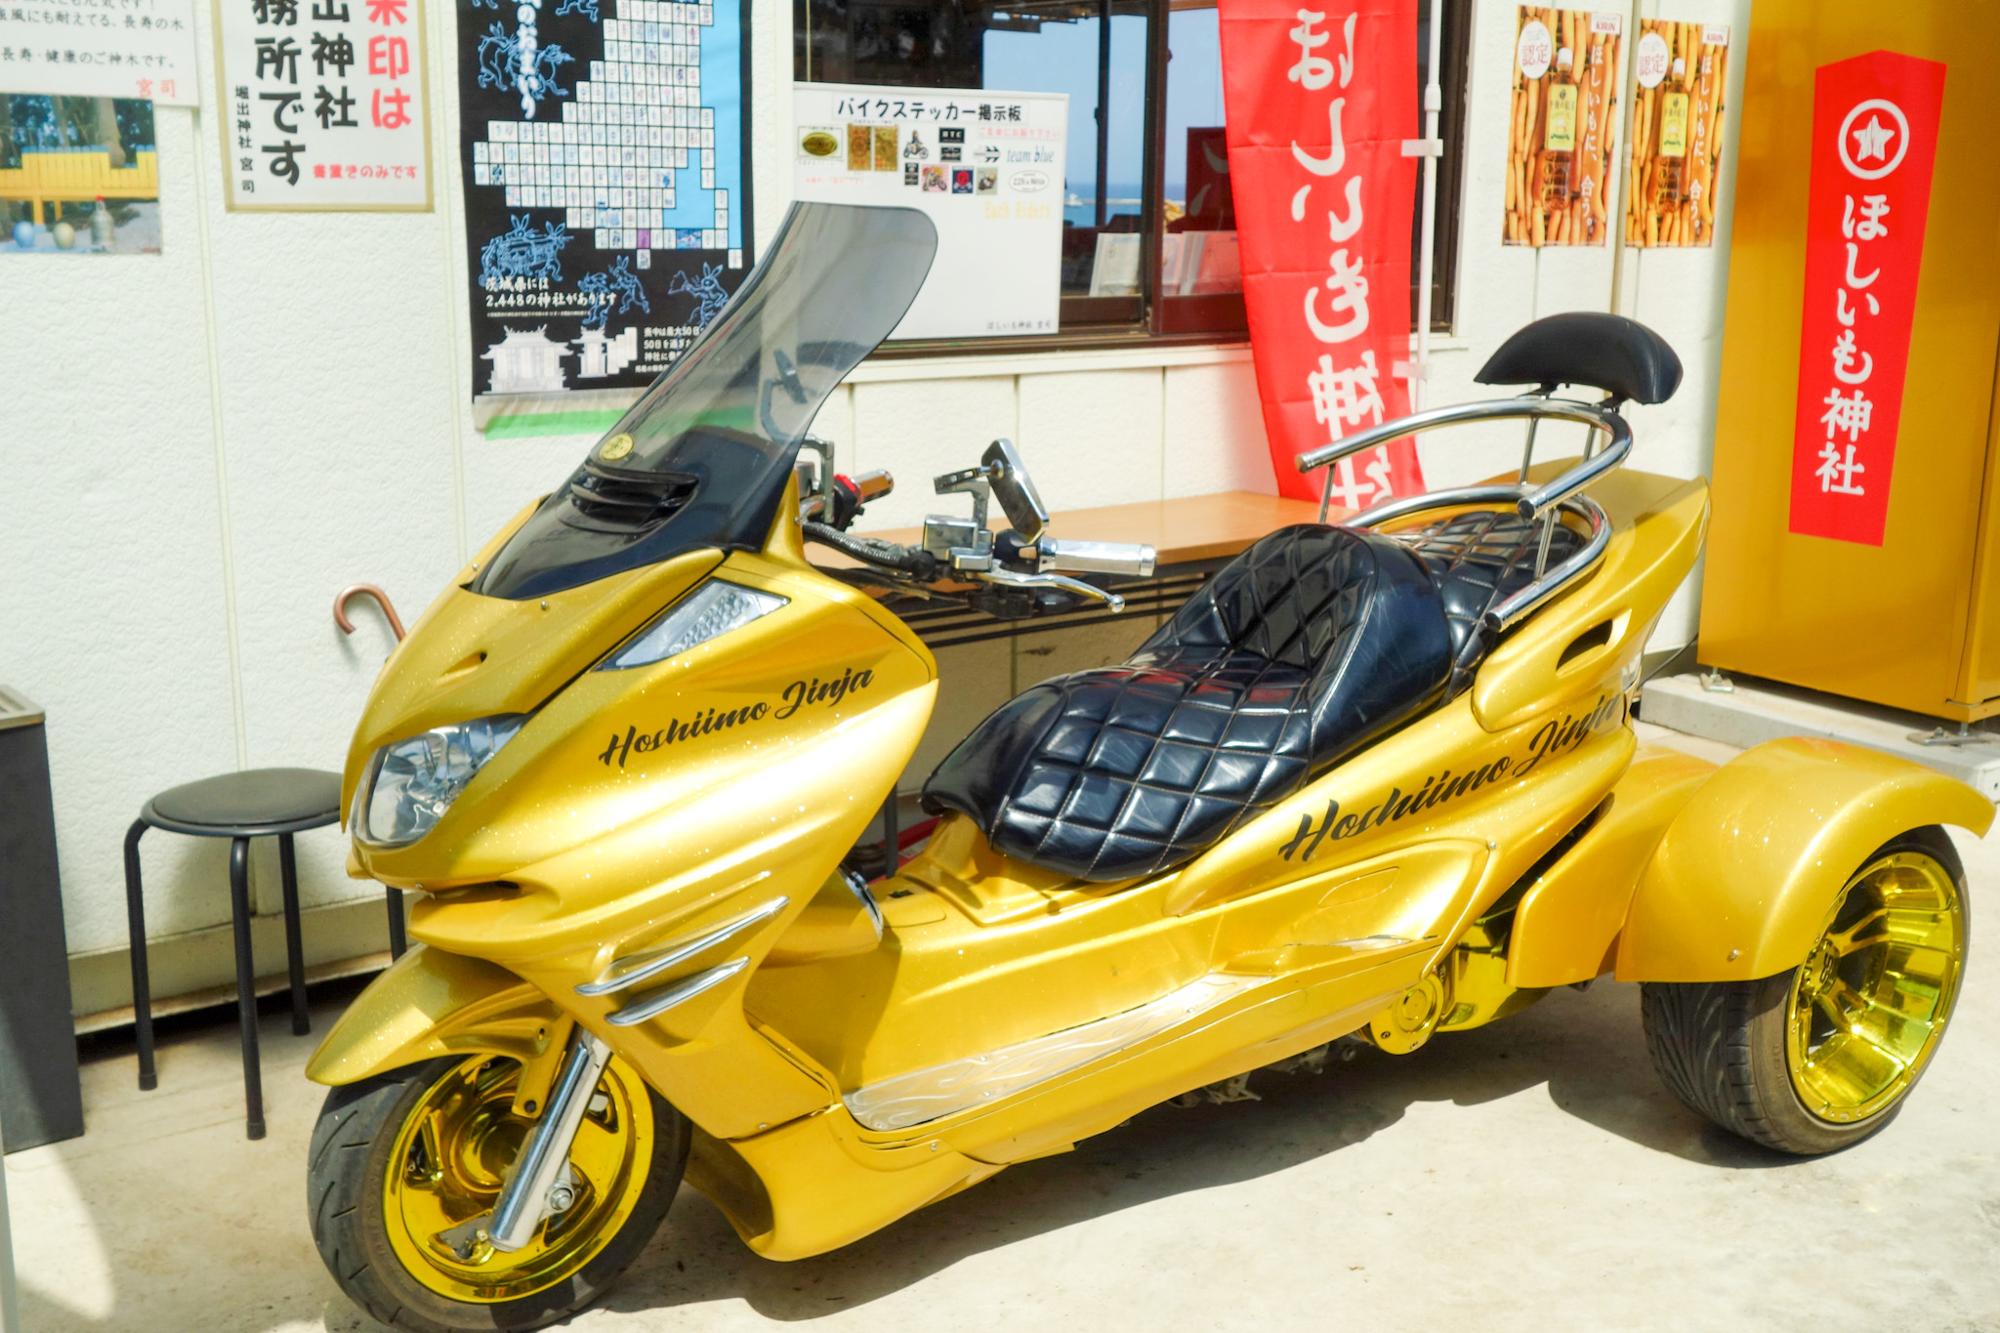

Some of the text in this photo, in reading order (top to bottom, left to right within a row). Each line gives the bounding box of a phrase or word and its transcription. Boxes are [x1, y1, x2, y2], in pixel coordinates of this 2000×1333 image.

[1596, 22, 1617, 32] KIRIN
[837, 97, 1022, 122] バイクステッカー掲示板
[1815, 194, 1891, 496] ほしいも神社
[598, 667, 874, 768] Hoshiimo Jinja
[1278, 755, 1513, 863] Hoshiimo
